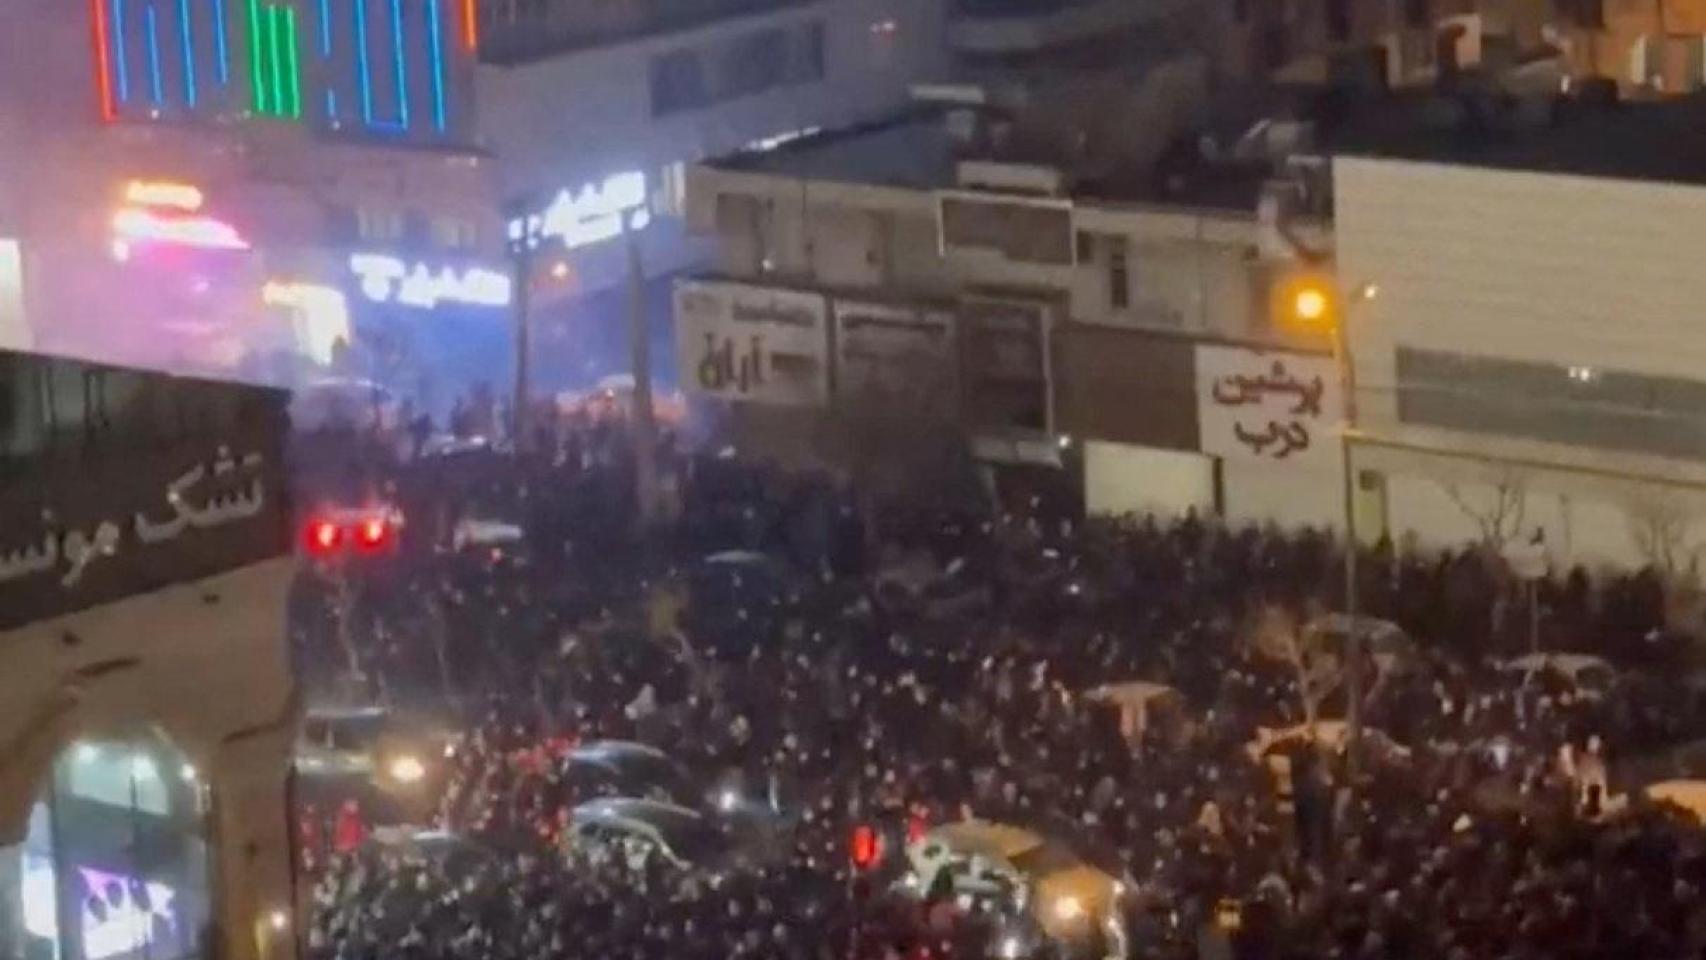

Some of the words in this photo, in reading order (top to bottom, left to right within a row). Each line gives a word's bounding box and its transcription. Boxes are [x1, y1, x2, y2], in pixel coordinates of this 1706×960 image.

[1211, 360, 1323, 418] پرشین
[1233, 421, 1309, 459] درب
[134, 445, 263, 543] تشک
